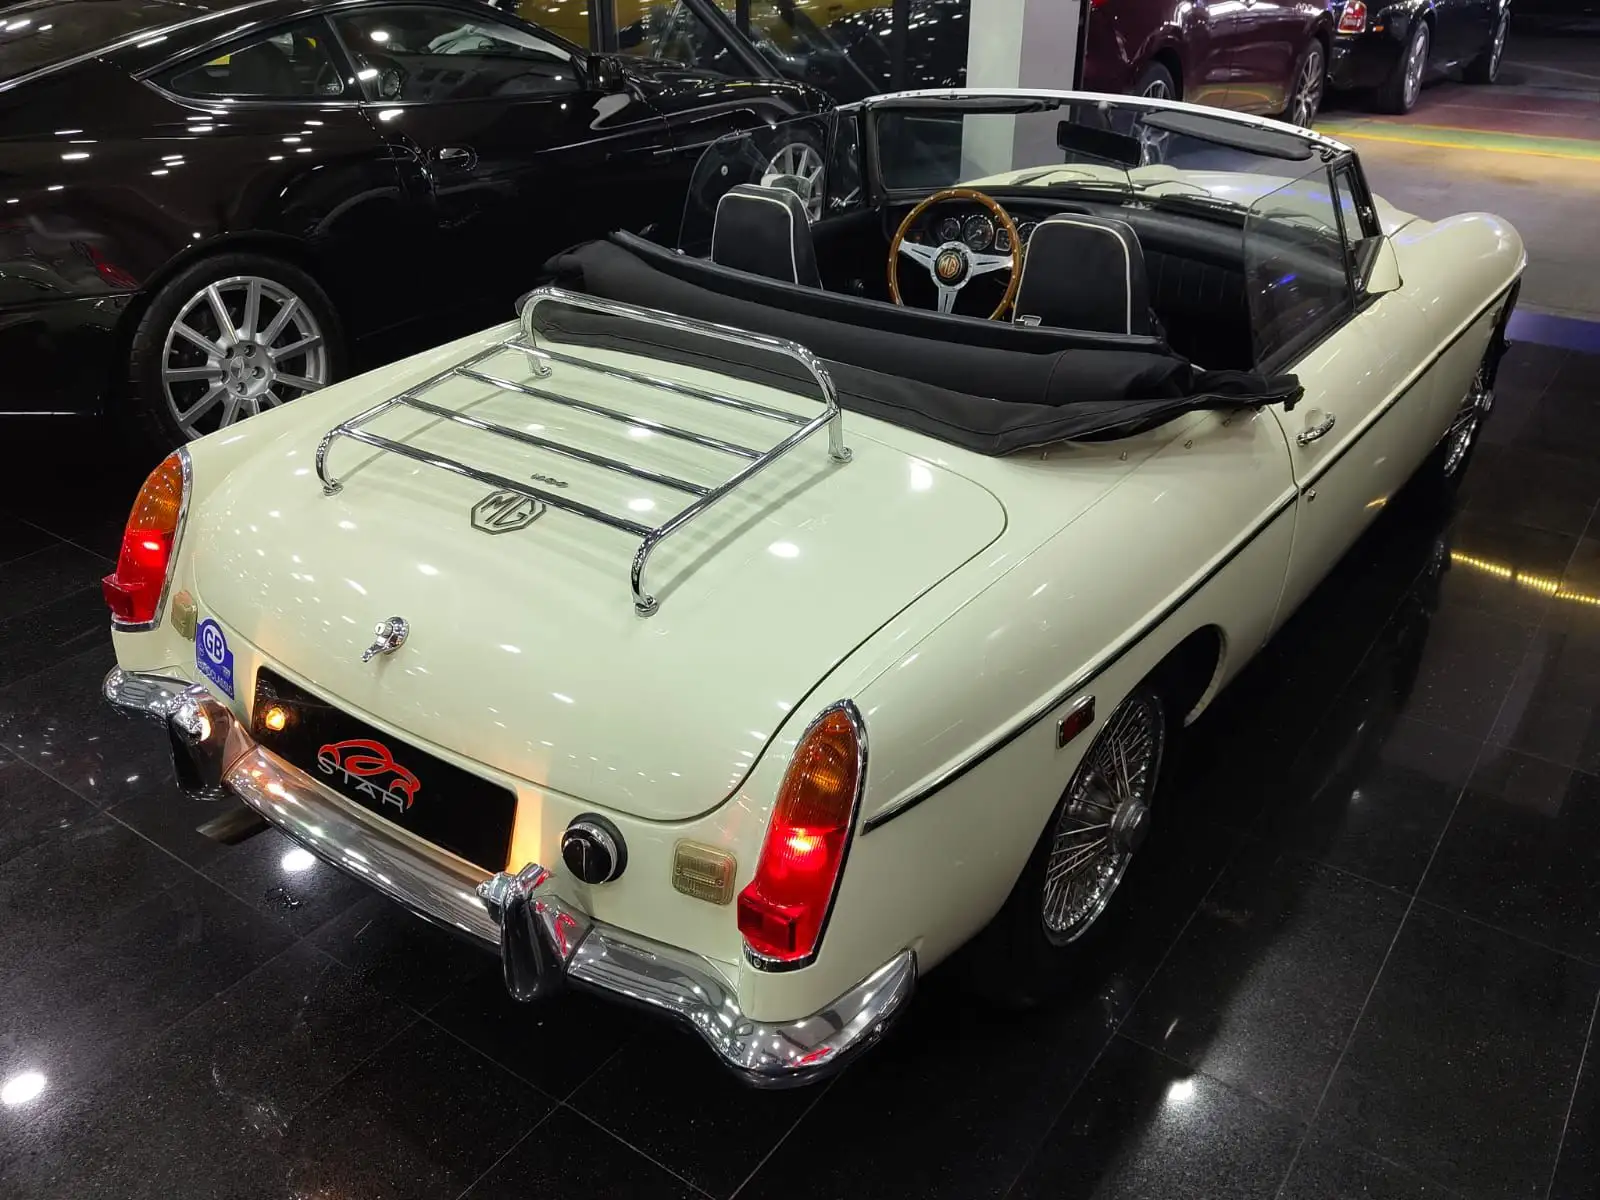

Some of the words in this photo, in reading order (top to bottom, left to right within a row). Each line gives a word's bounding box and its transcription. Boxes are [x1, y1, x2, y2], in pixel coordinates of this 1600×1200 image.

[939, 255, 958, 277] MG
[479, 494, 536, 528] MG
[204, 627, 223, 661] GB
[317, 756, 404, 813] STAR
